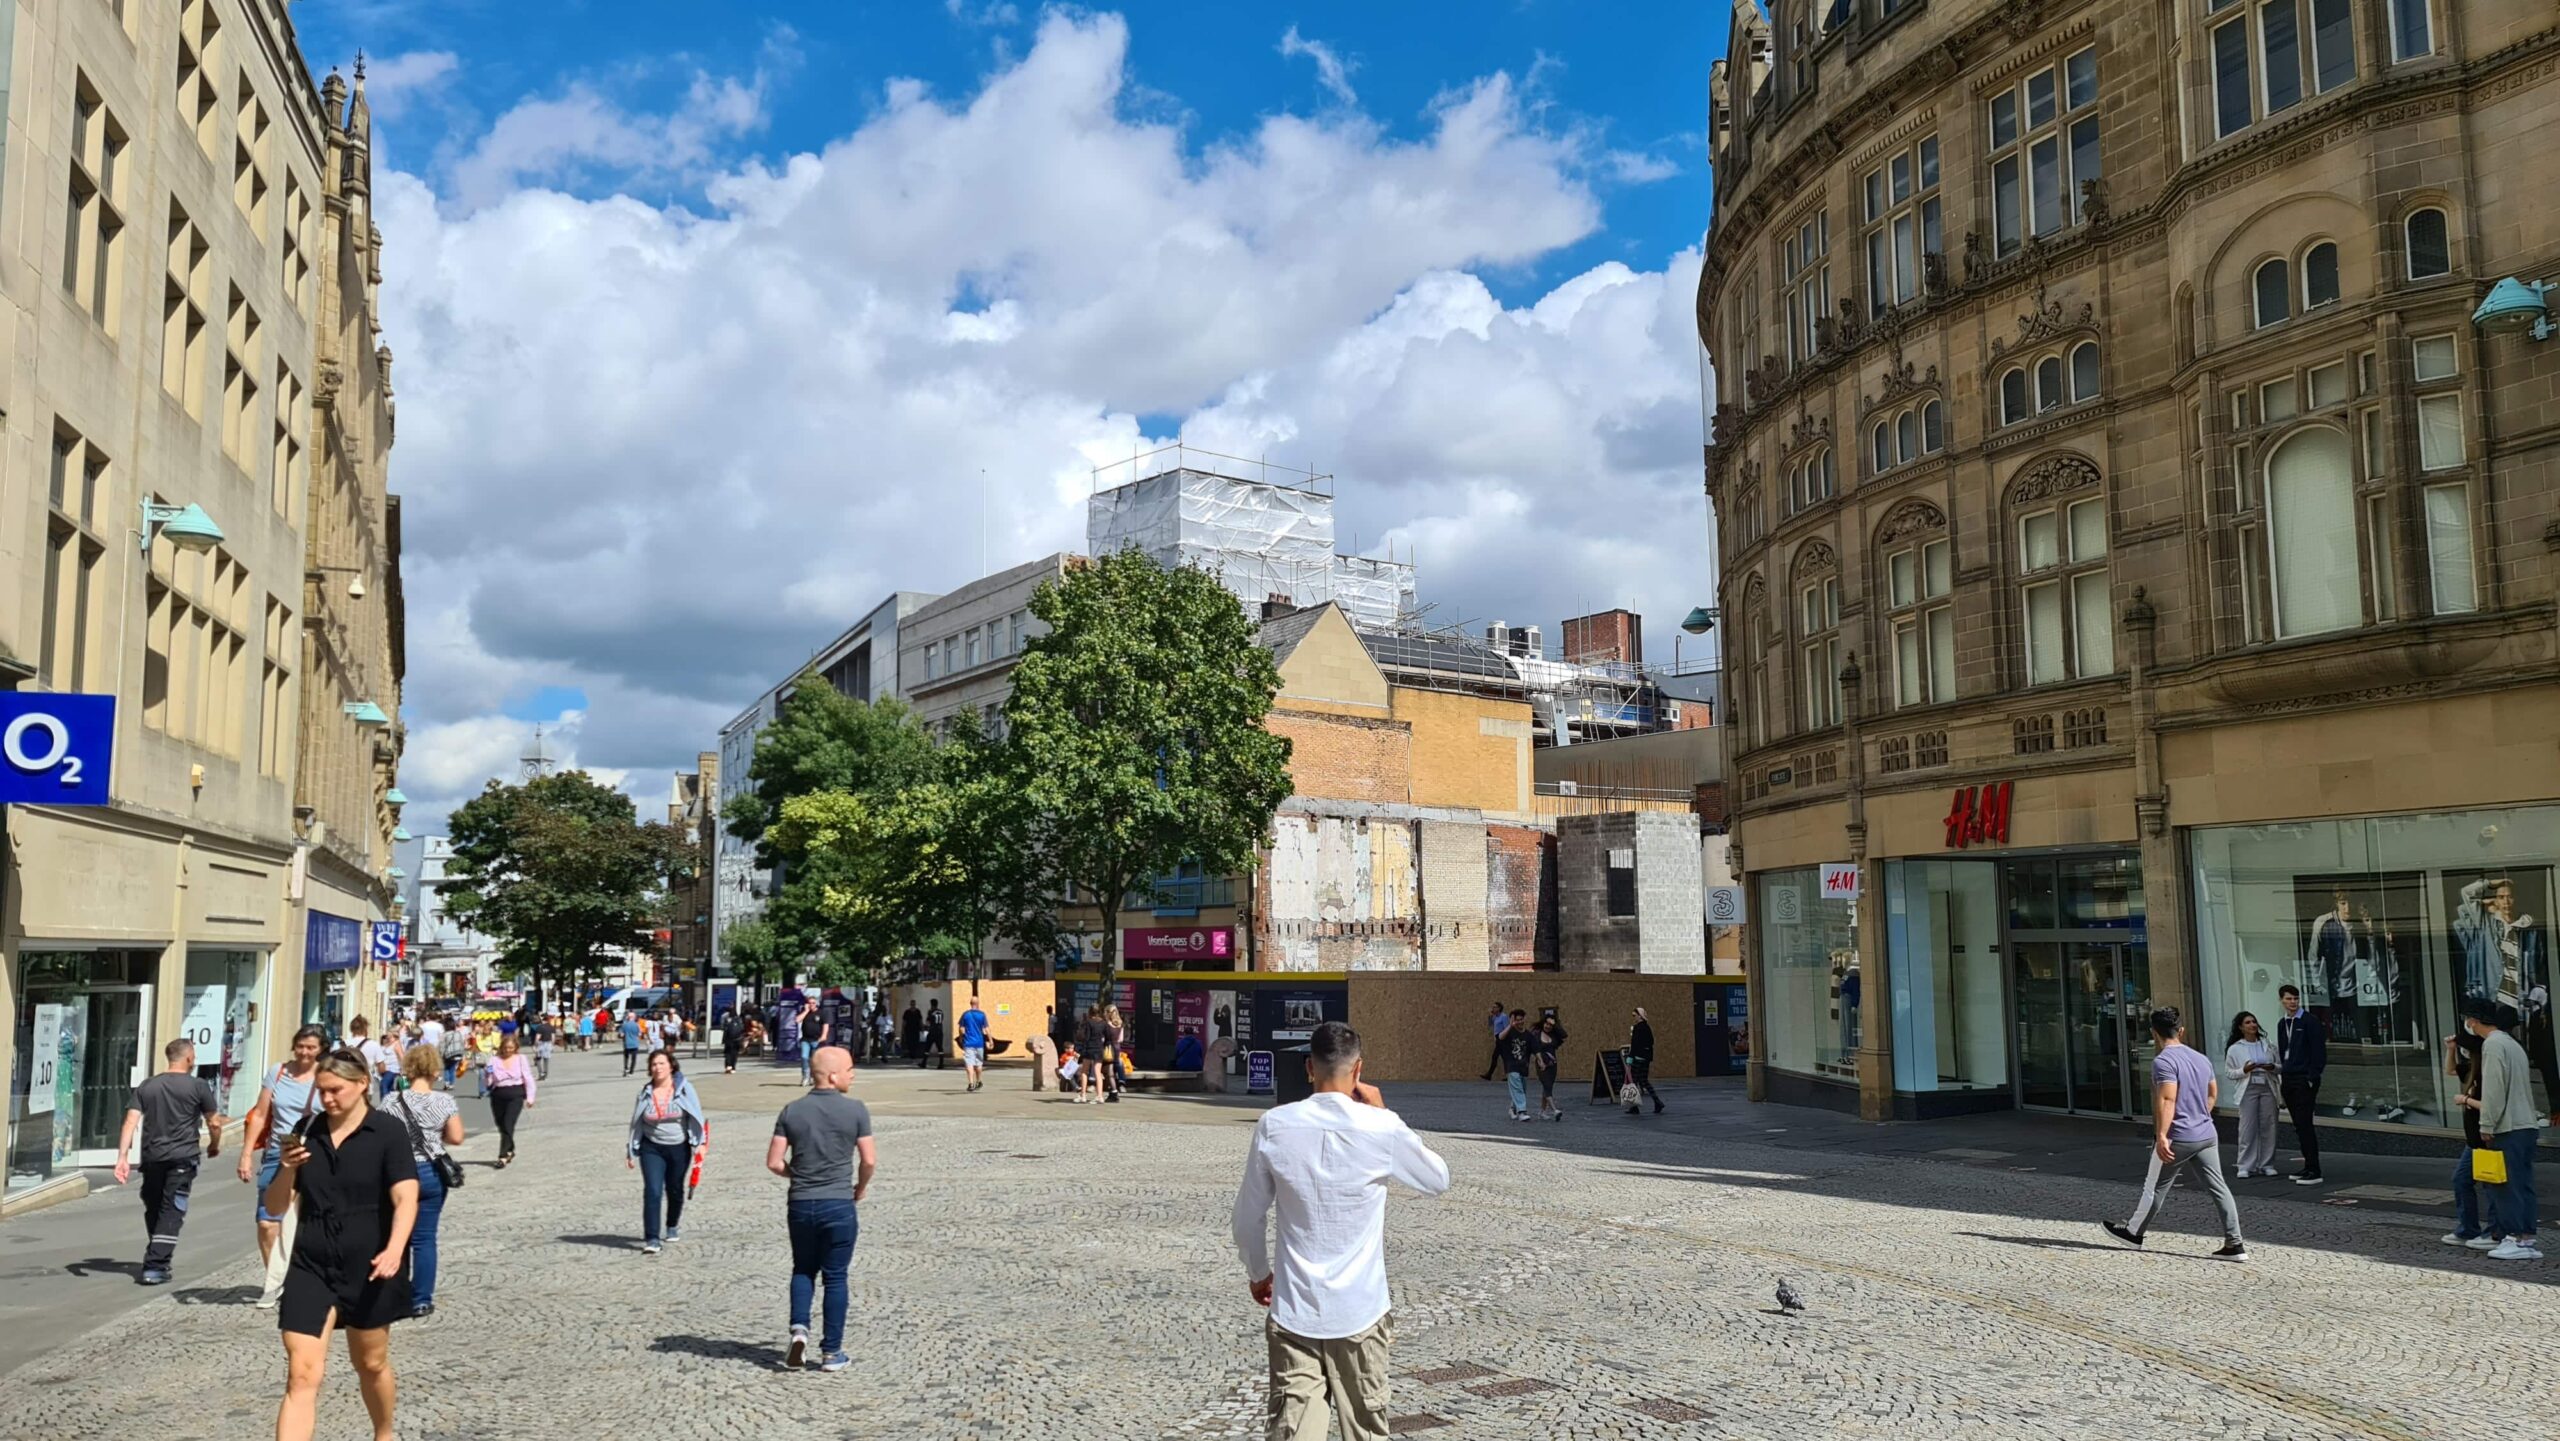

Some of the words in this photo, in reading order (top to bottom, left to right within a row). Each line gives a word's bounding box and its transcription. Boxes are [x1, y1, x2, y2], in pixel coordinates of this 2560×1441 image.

[1943, 782, 2014, 848] H&M
[1827, 871, 1855, 891] H&M
[1712, 889, 1735, 917] 3
[374, 931, 396, 959] S
